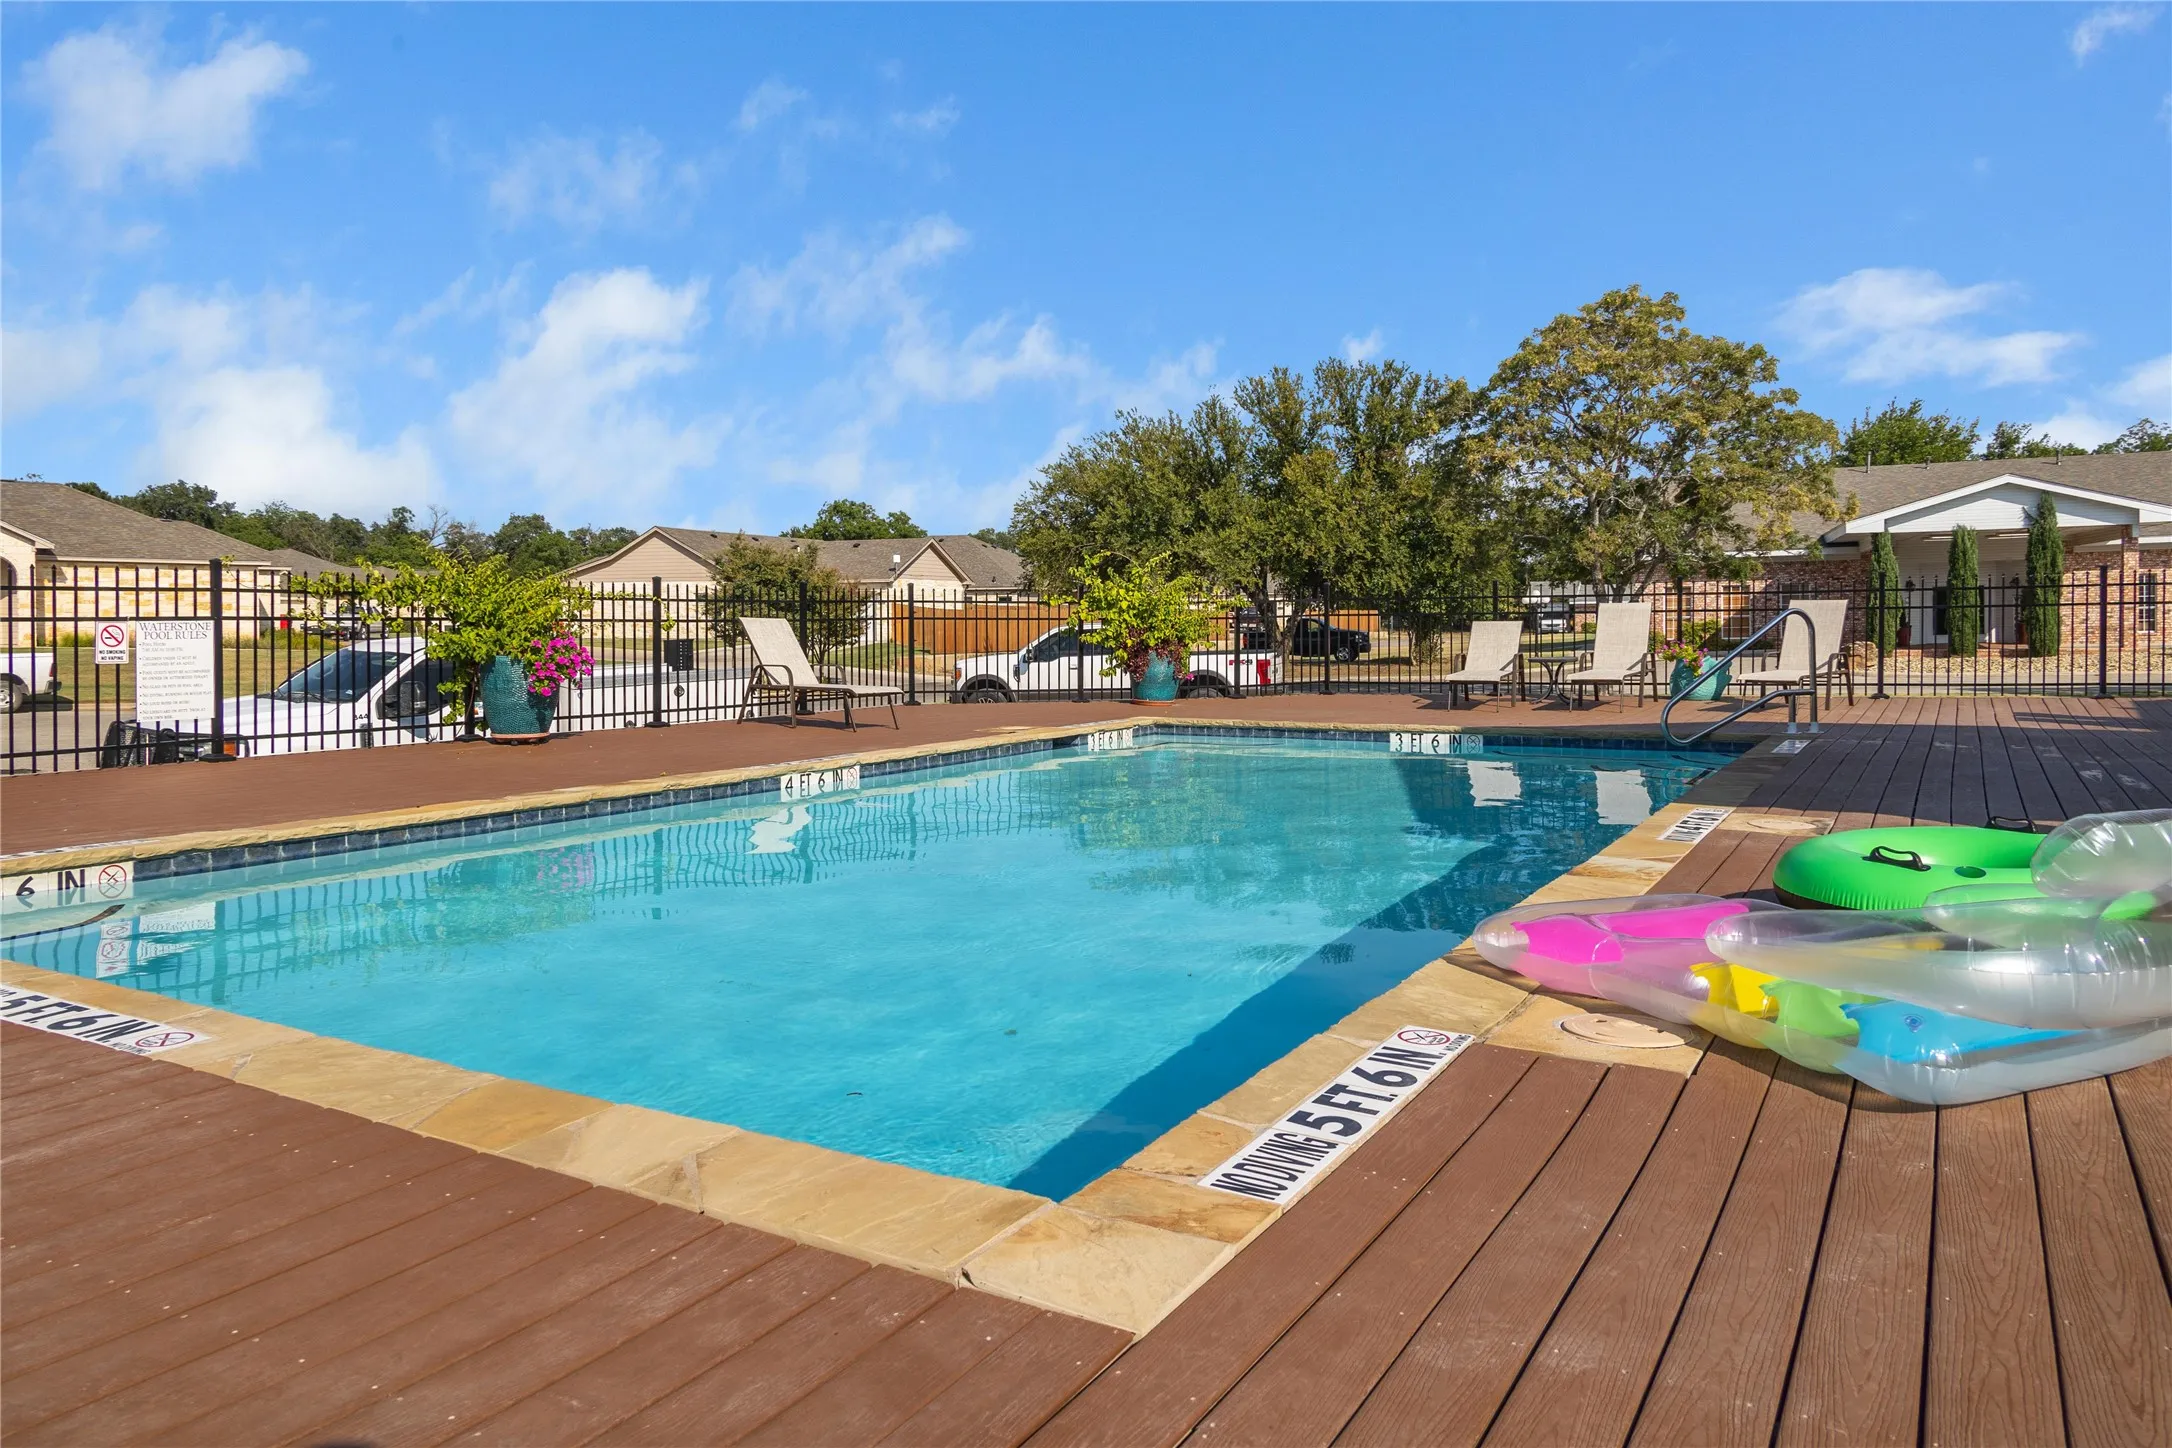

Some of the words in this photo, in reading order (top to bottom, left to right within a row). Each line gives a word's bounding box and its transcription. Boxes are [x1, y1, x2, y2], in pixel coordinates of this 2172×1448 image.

[139, 622, 211, 631] WATERSTONE
[144, 631, 173, 640] POOL
[175, 631, 208, 640] RULES
[1449, 734, 1461, 745] IN
[785, 775, 794, 789] 4
[832, 769, 843, 783] IN
[15, 876, 36, 896] 6
[57, 868, 85, 891] IN
[46, 1013, 119, 1031] 6
[1351, 1066, 1418, 1088] 6
[1286, 1110, 1363, 1138] 5
[1232, 1132, 1339, 1183] DIVING
[1210, 1171, 1289, 1201] NO
